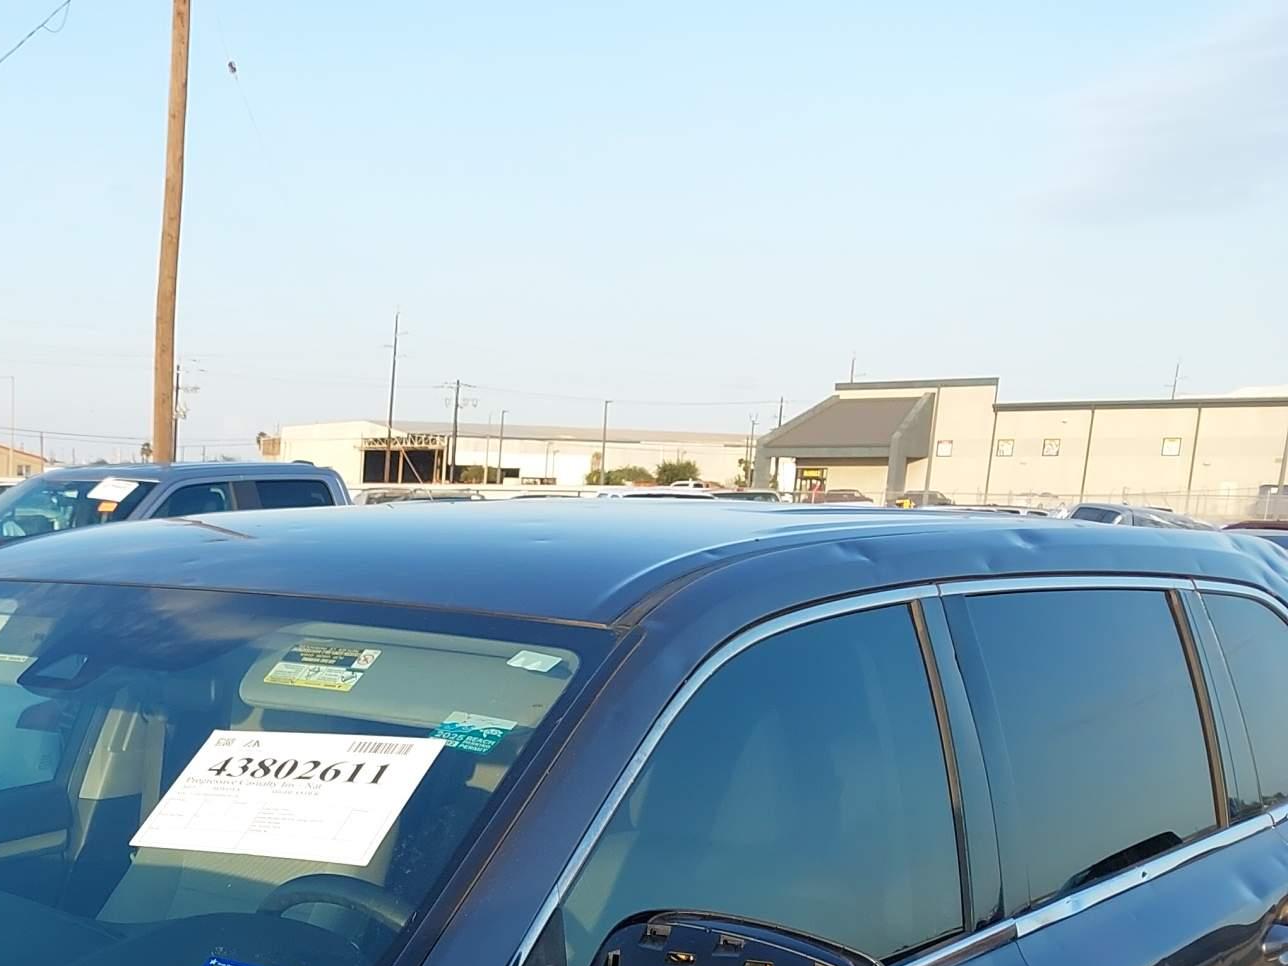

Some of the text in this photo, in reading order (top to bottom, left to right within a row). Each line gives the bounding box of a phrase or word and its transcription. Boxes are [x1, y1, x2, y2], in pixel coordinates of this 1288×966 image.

[434, 731, 467, 741] 2025
[464, 735, 497, 746] BEACH
[458, 744, 489, 753] PERMIT
[208, 756, 391, 785] 43802611
